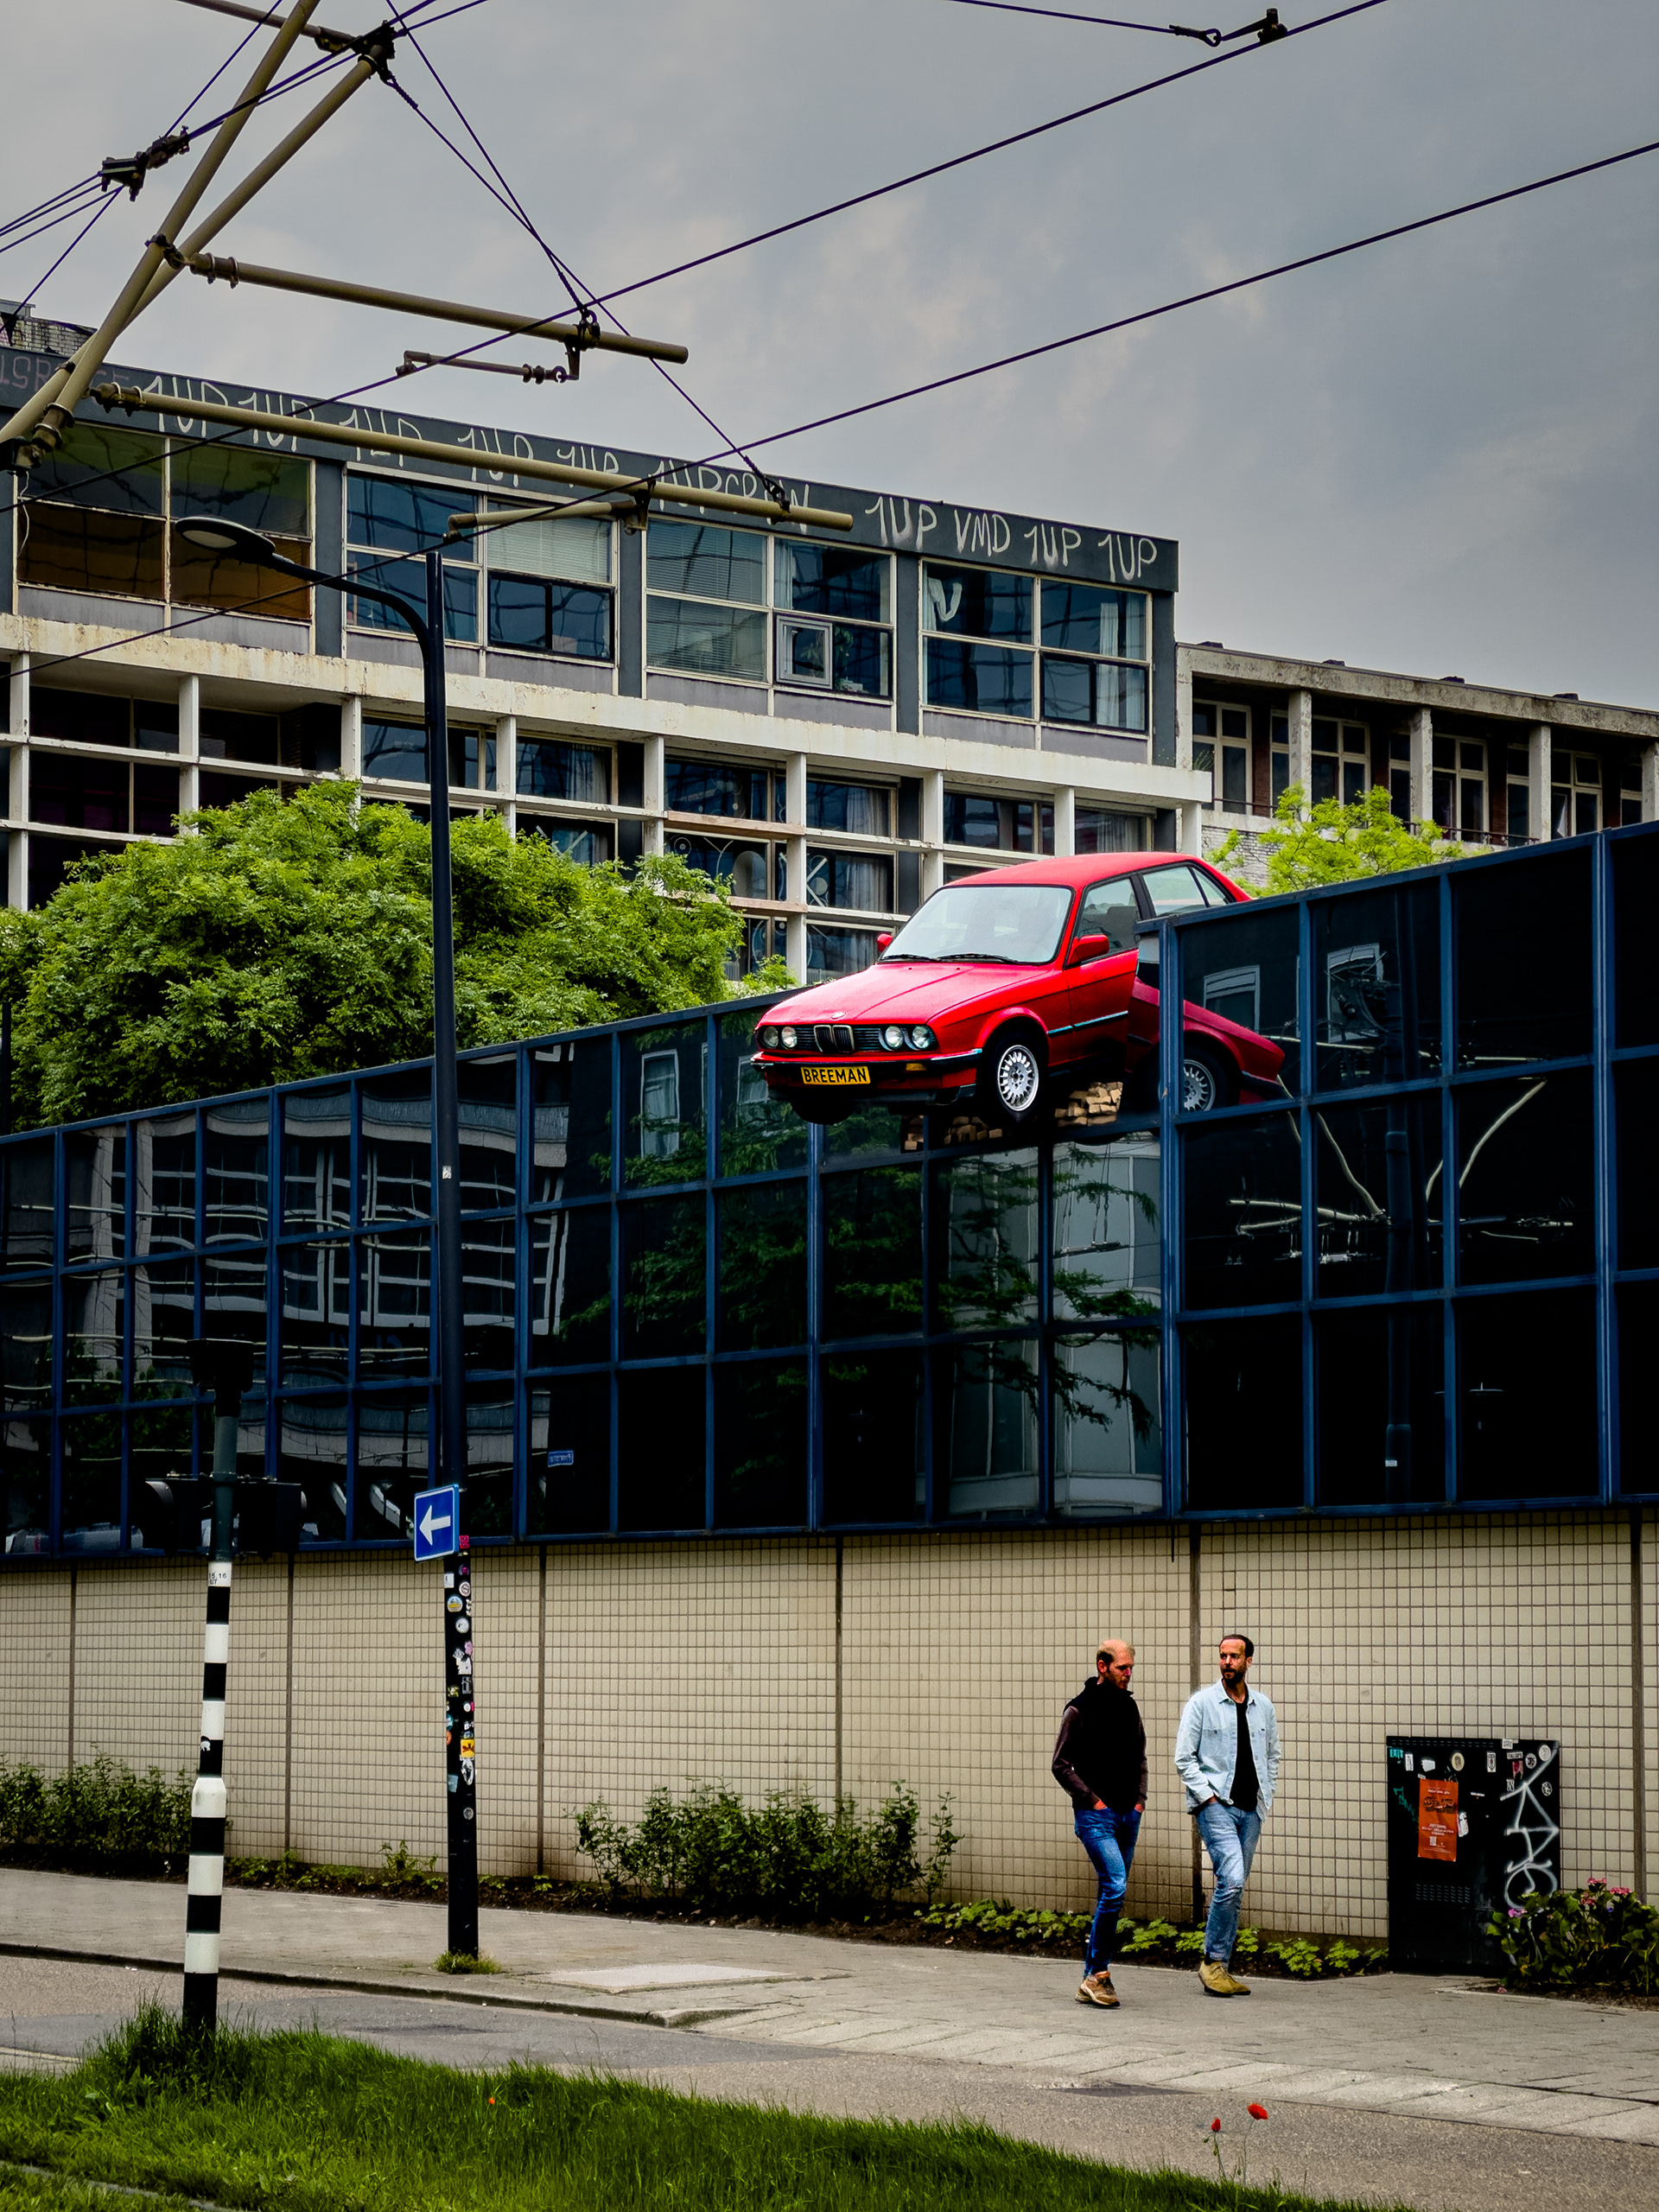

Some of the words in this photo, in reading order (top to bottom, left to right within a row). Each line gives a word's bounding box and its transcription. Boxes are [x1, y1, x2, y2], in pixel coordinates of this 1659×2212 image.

[865, 496, 938, 550] 1UP
[955, 509, 1011, 556] VMD
[1024, 524, 1082, 569] 1UP
[1097, 533, 1158, 582] 1UP
[803, 1068, 868, 1084] BREEMAN
